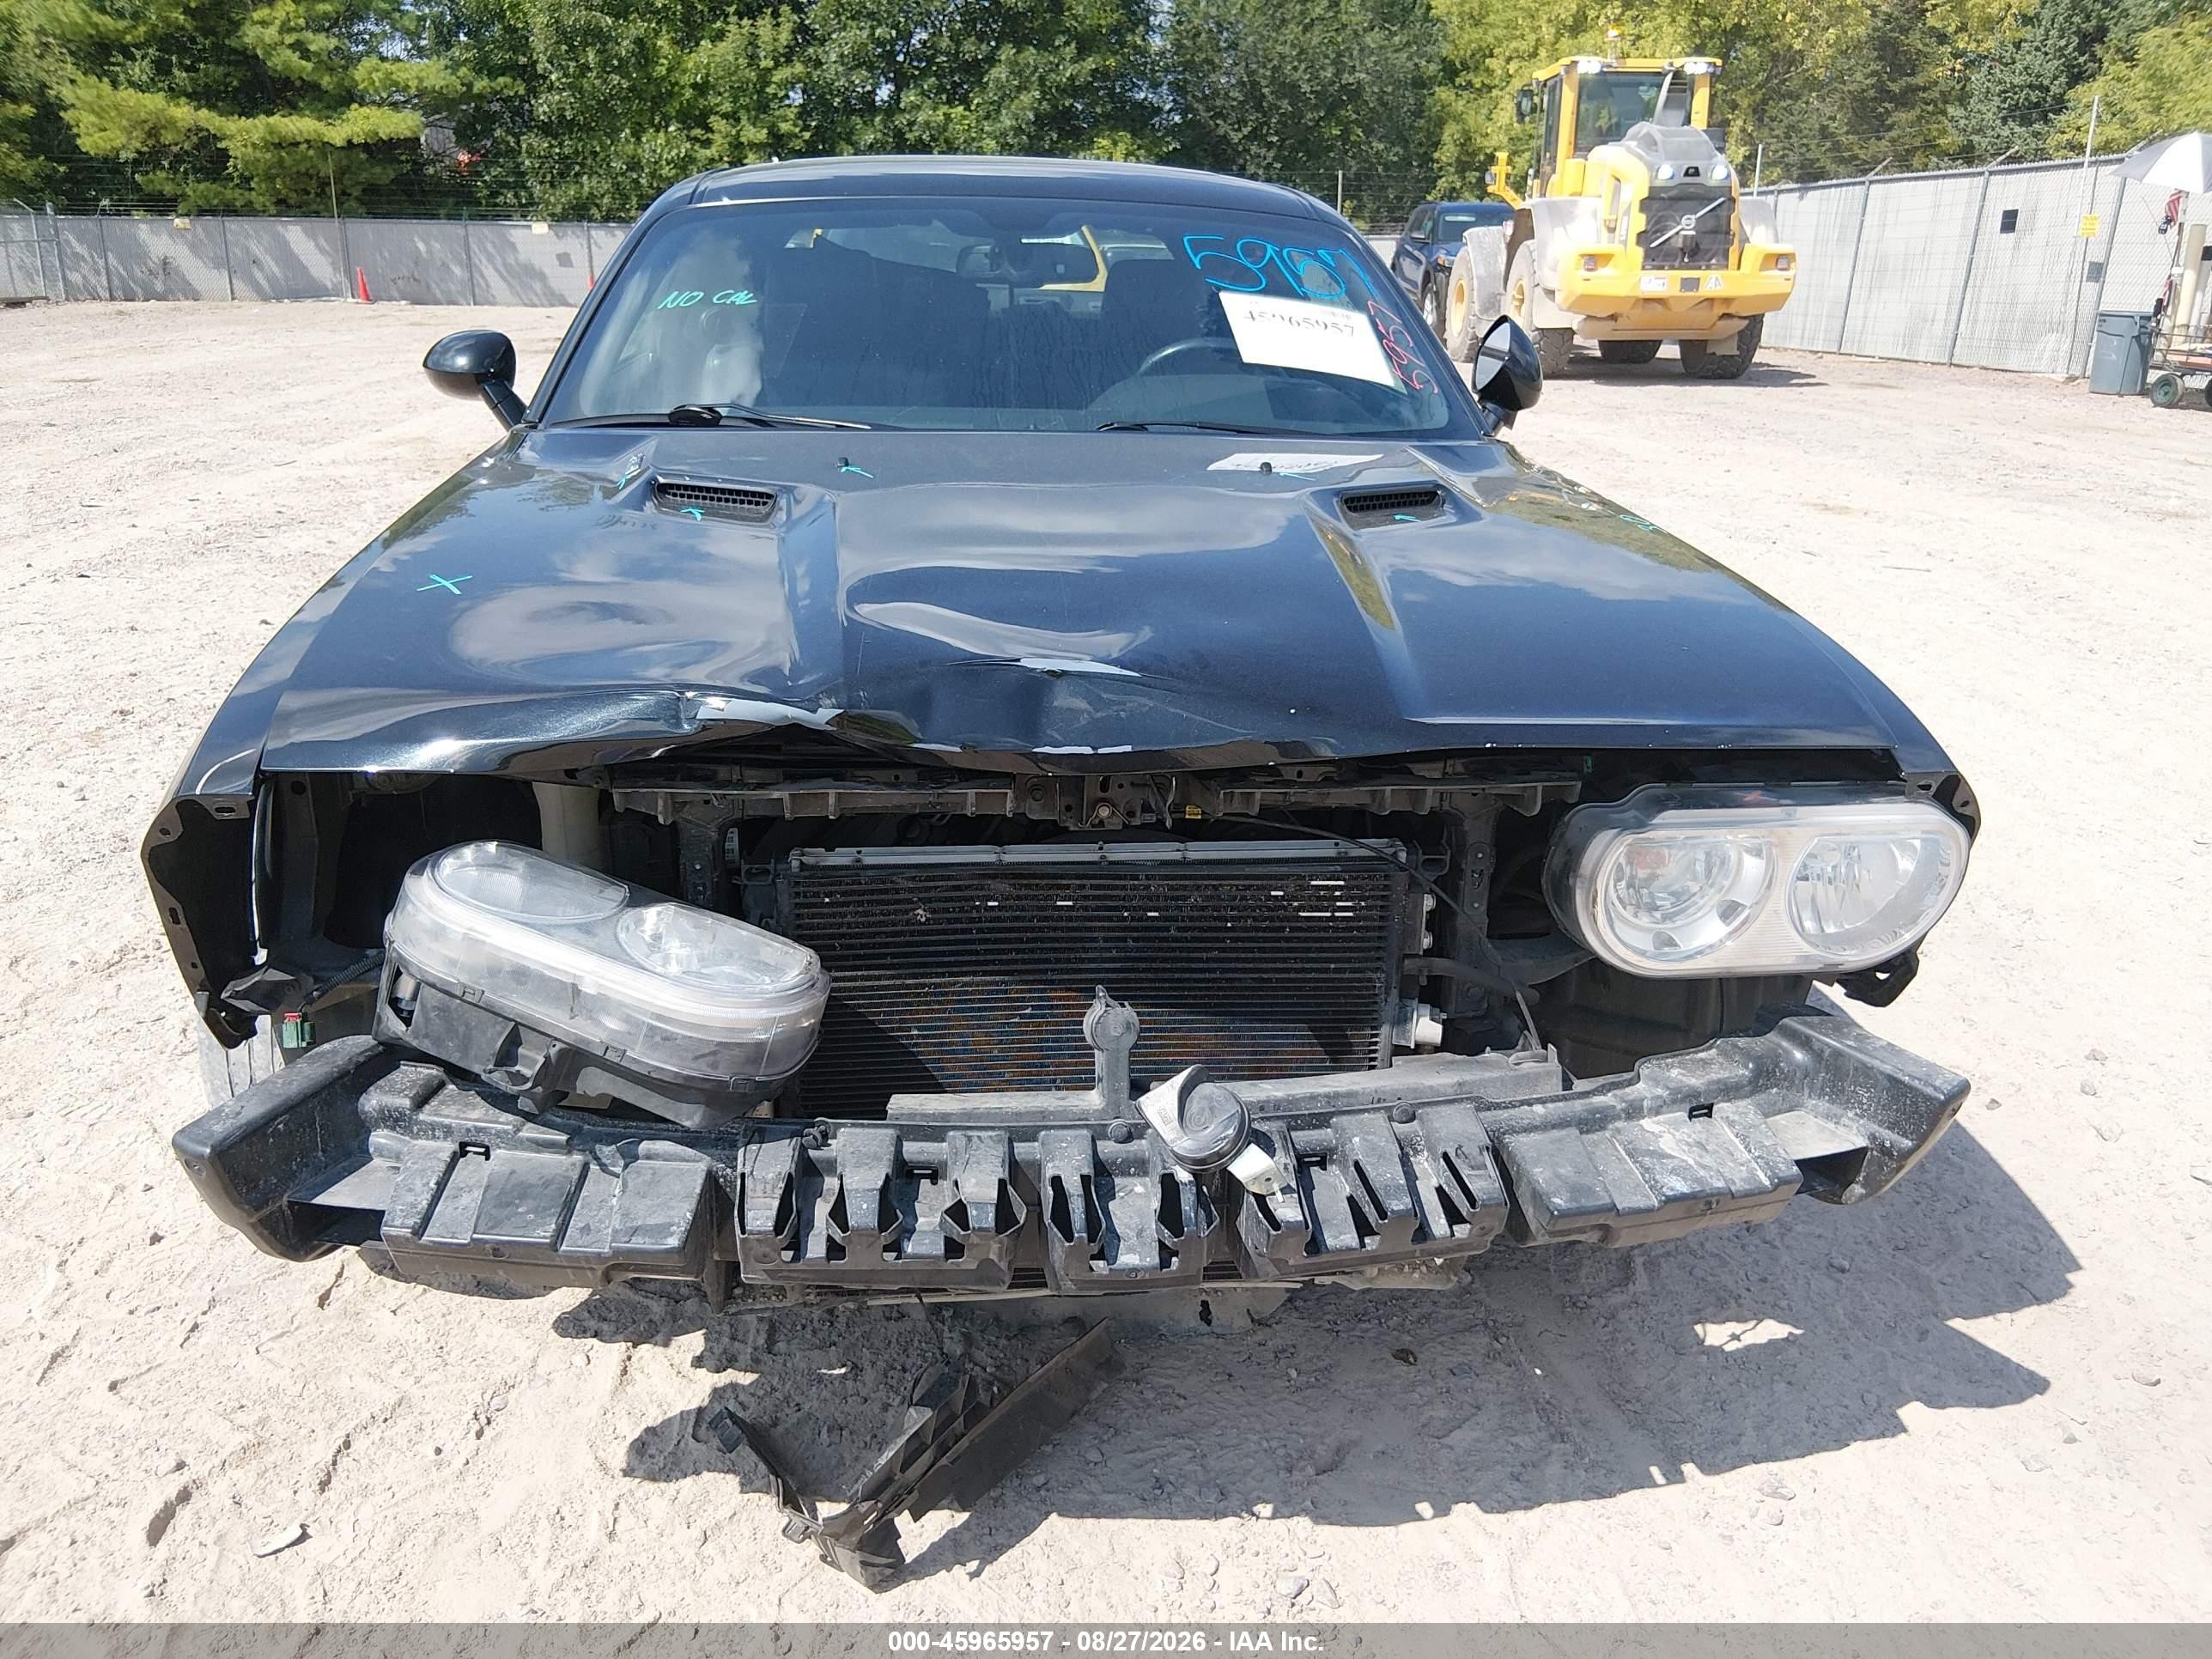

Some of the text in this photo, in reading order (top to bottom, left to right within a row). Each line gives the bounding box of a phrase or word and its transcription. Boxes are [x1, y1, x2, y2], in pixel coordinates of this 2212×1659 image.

[657, 290, 704, 309] NO
[1182, 234, 1379, 301] 5957
[1367, 301, 1439, 394] 5957
